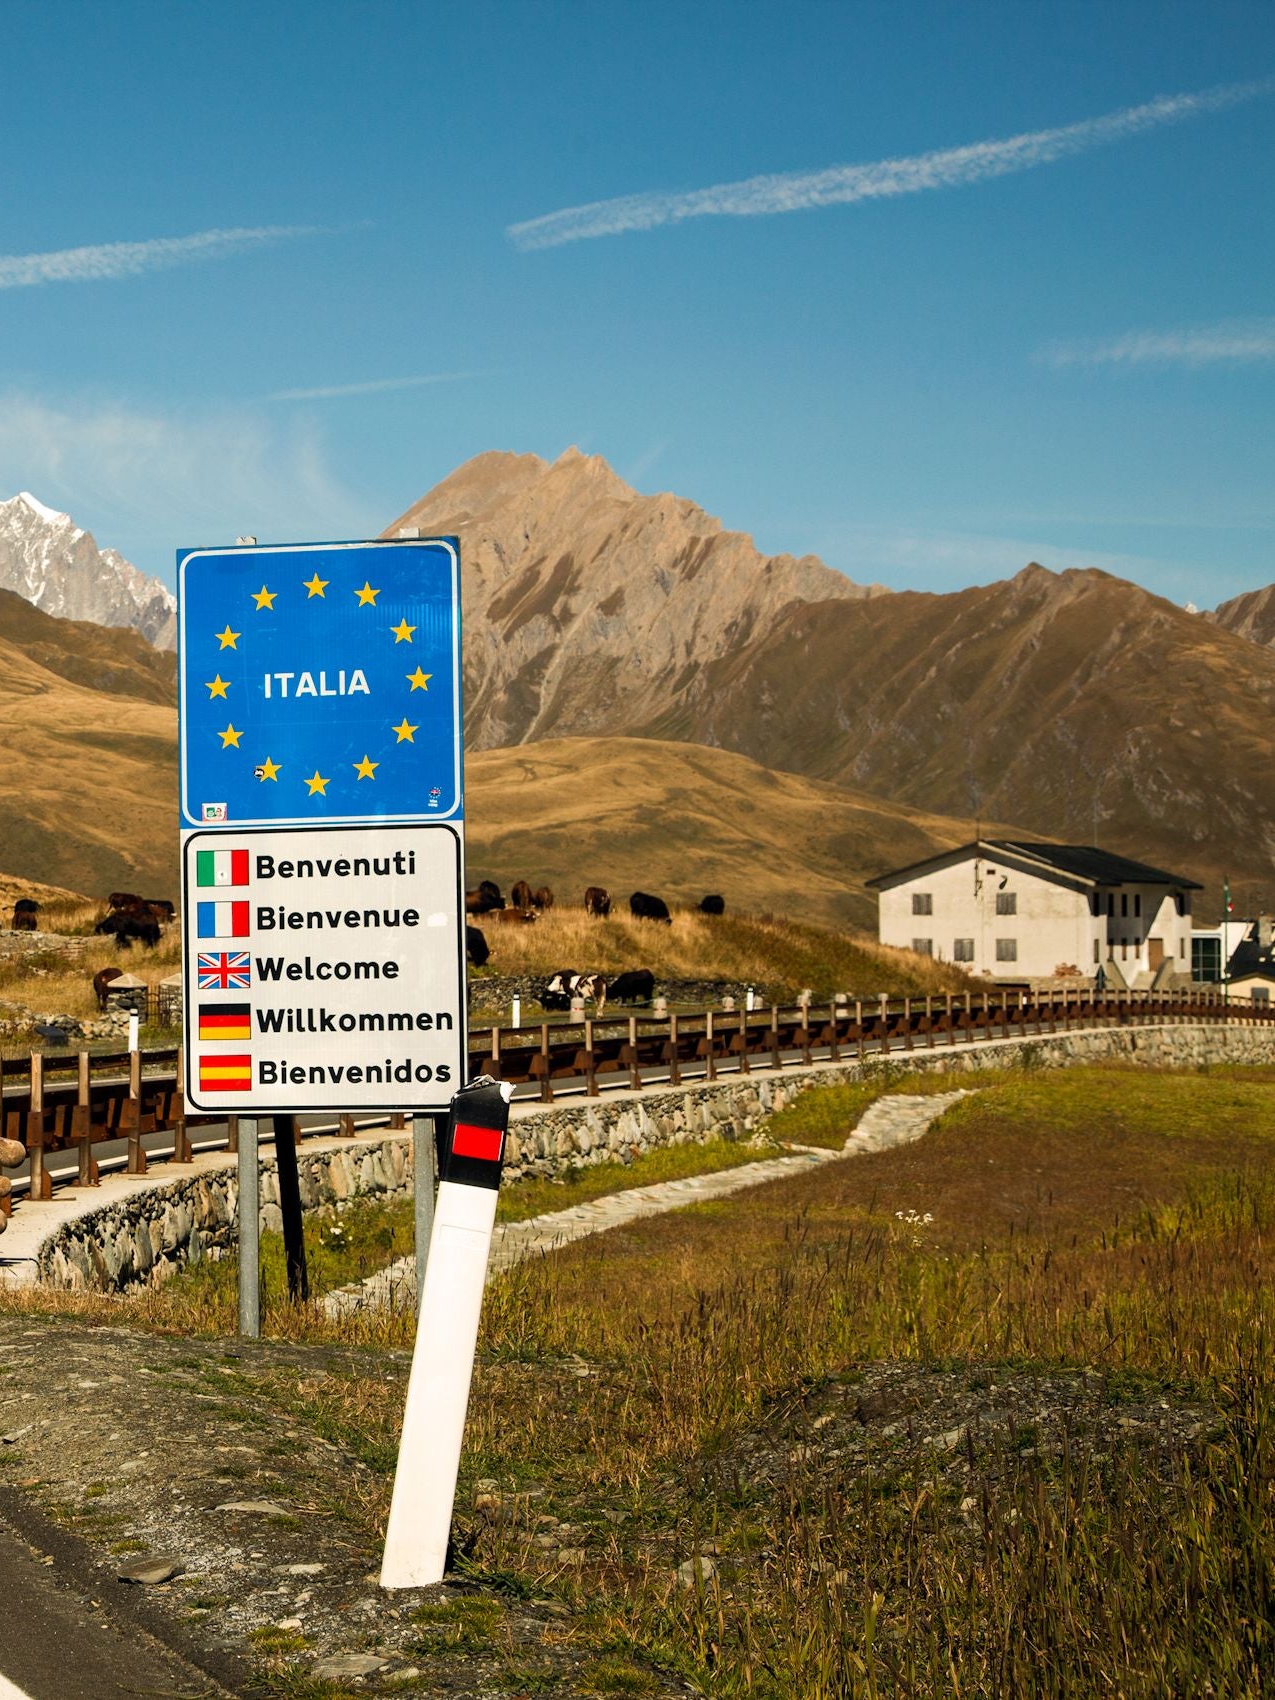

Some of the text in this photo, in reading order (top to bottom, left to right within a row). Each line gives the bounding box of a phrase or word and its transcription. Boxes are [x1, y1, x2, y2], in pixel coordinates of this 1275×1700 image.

[264, 669, 371, 699] ITALIA
[256, 850, 416, 879] Benvenuti
[256, 905, 420, 931] Bienvenue
[255, 956, 400, 982] Welcome
[255, 1007, 453, 1033] Willkommen
[258, 1058, 451, 1085] Bienvenidos
